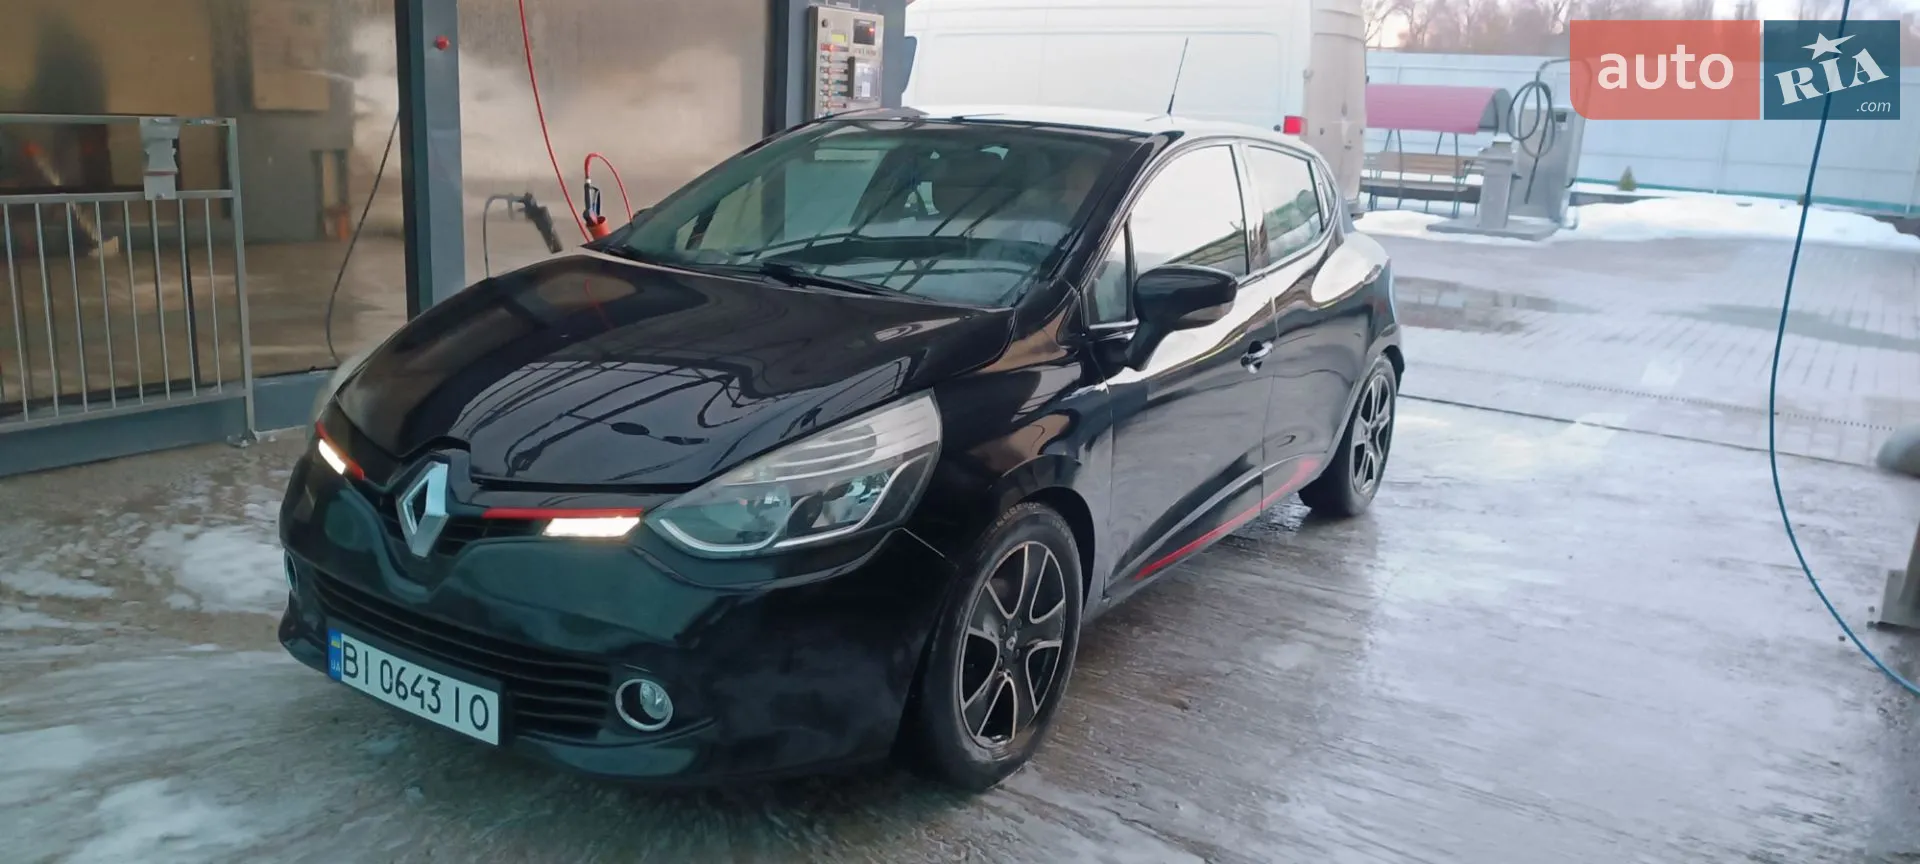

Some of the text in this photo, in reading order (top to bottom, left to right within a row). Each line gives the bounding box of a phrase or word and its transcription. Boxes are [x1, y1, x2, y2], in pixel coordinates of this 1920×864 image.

[331, 660, 341, 672] UA
[343, 641, 489, 731] BI 0643 IO
